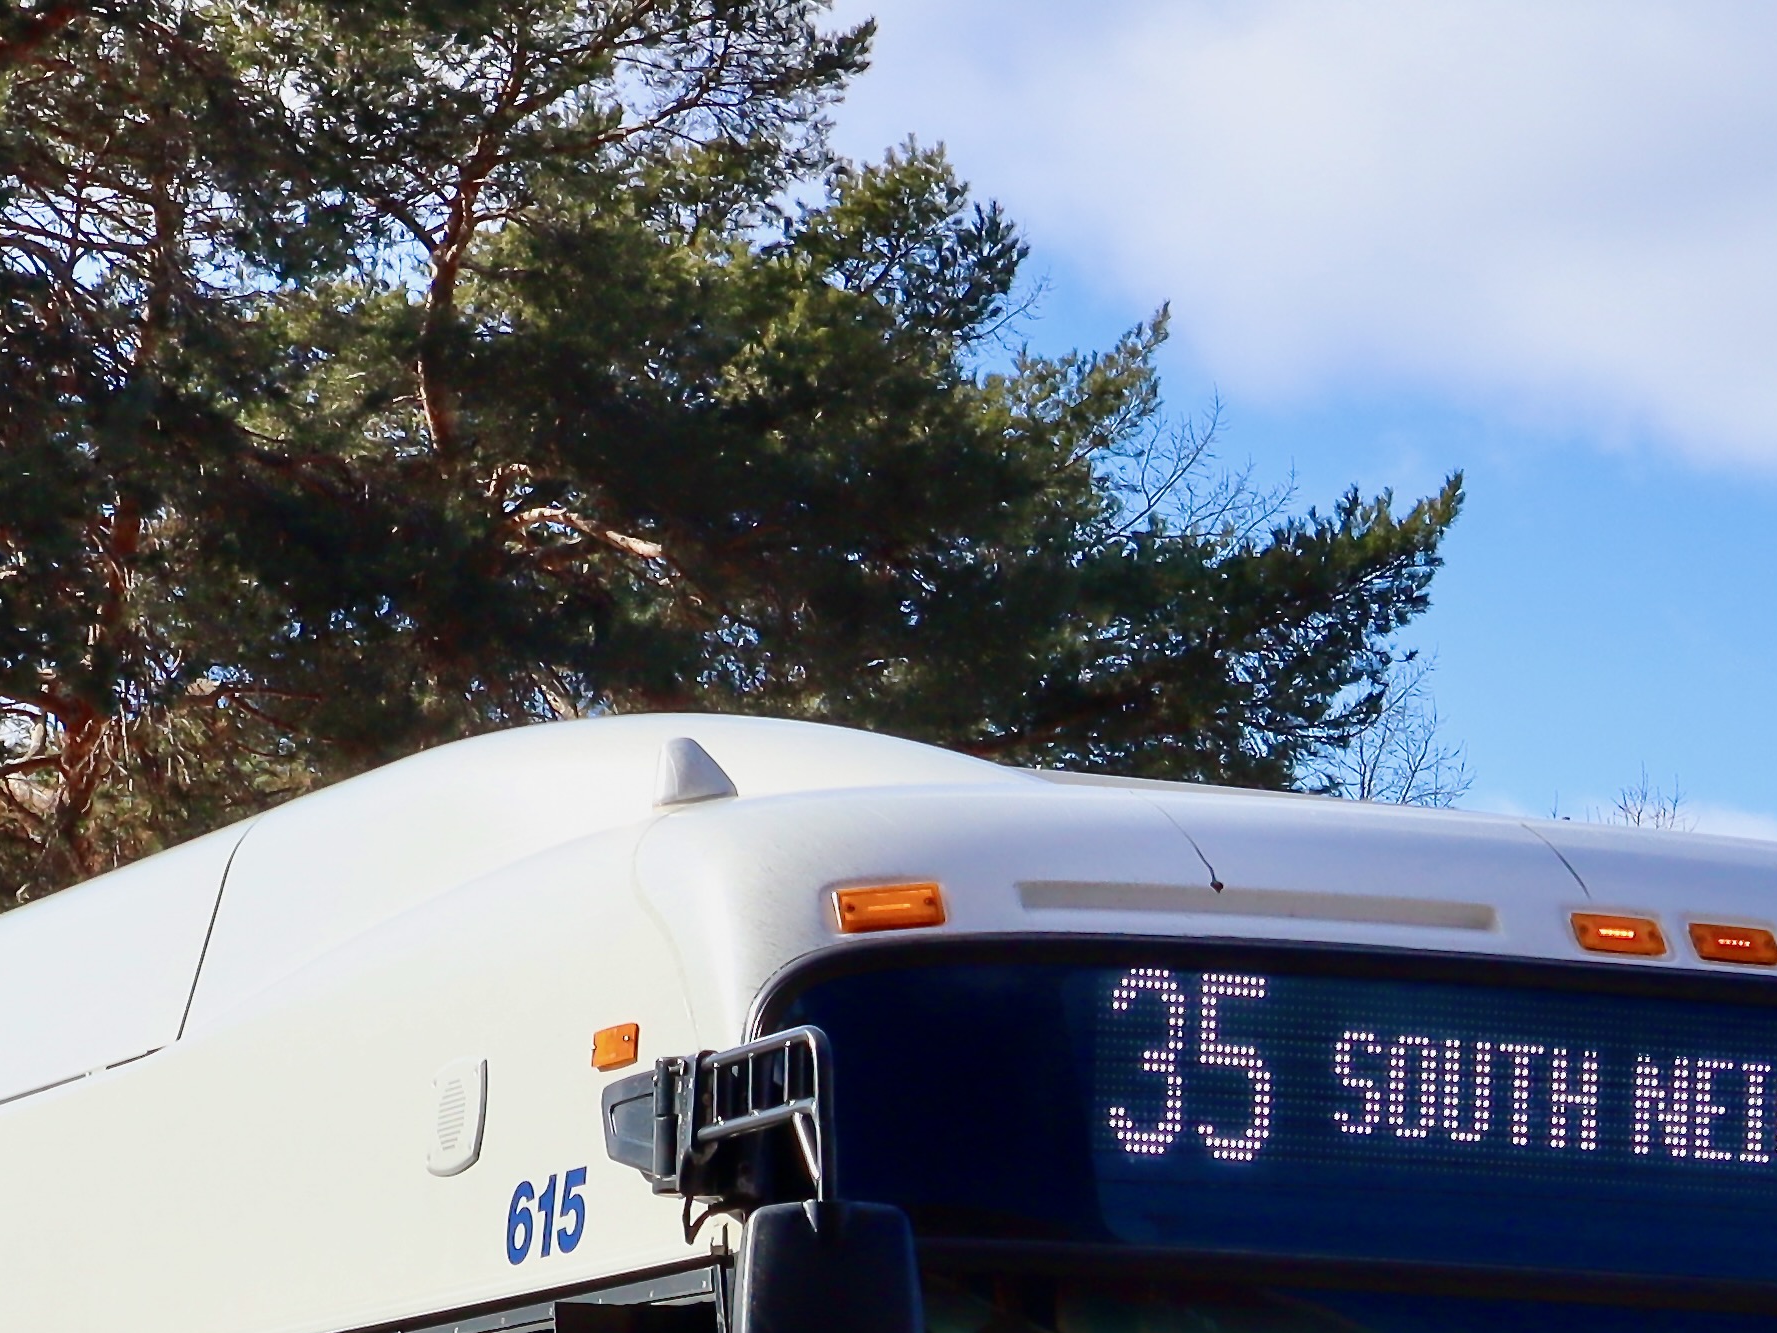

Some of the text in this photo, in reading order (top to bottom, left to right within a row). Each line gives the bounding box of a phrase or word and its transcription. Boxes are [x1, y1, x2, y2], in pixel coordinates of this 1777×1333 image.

[1109, 968, 1270, 1161] 35
[1334, 1031, 1598, 1150] SOUTH
[506, 1166, 587, 1265] 615
